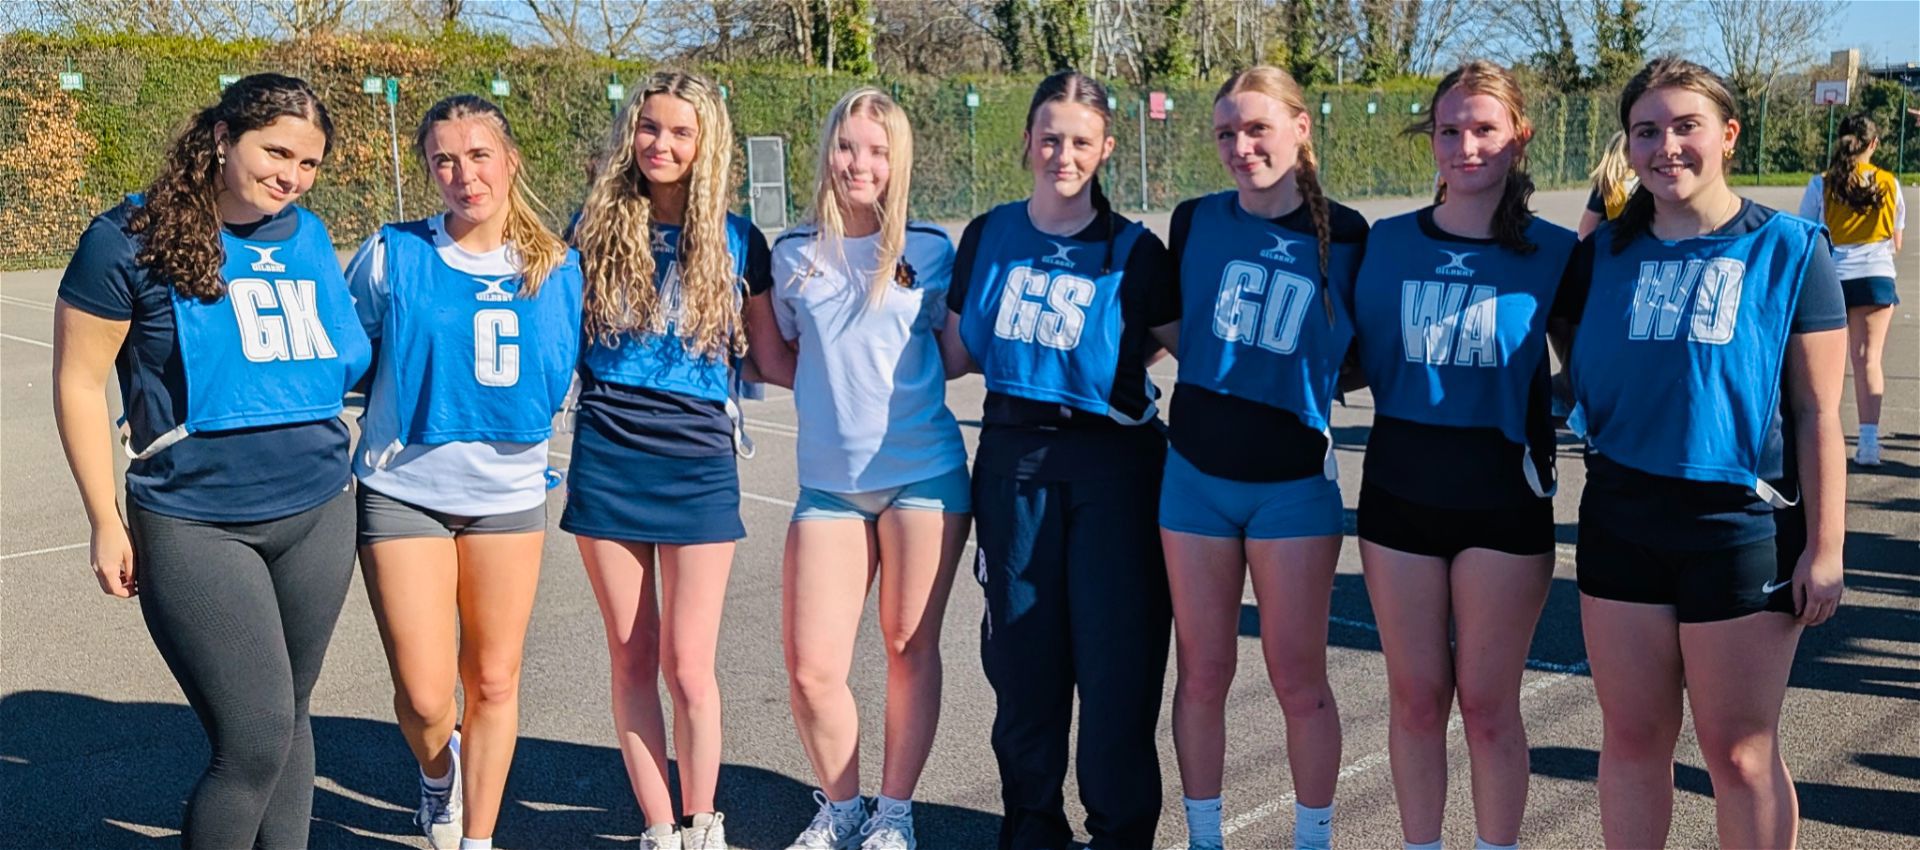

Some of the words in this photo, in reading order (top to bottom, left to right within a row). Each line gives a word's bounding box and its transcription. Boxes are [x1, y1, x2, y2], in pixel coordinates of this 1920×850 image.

[994, 266, 1096, 351] GS
[1212, 260, 1316, 355] GD
[1435, 266, 1475, 277] GILBERT
[1628, 256, 1746, 345] WD
[228, 278, 338, 362] GK
[474, 309, 519, 387] C
[1401, 280, 1497, 367] WA
